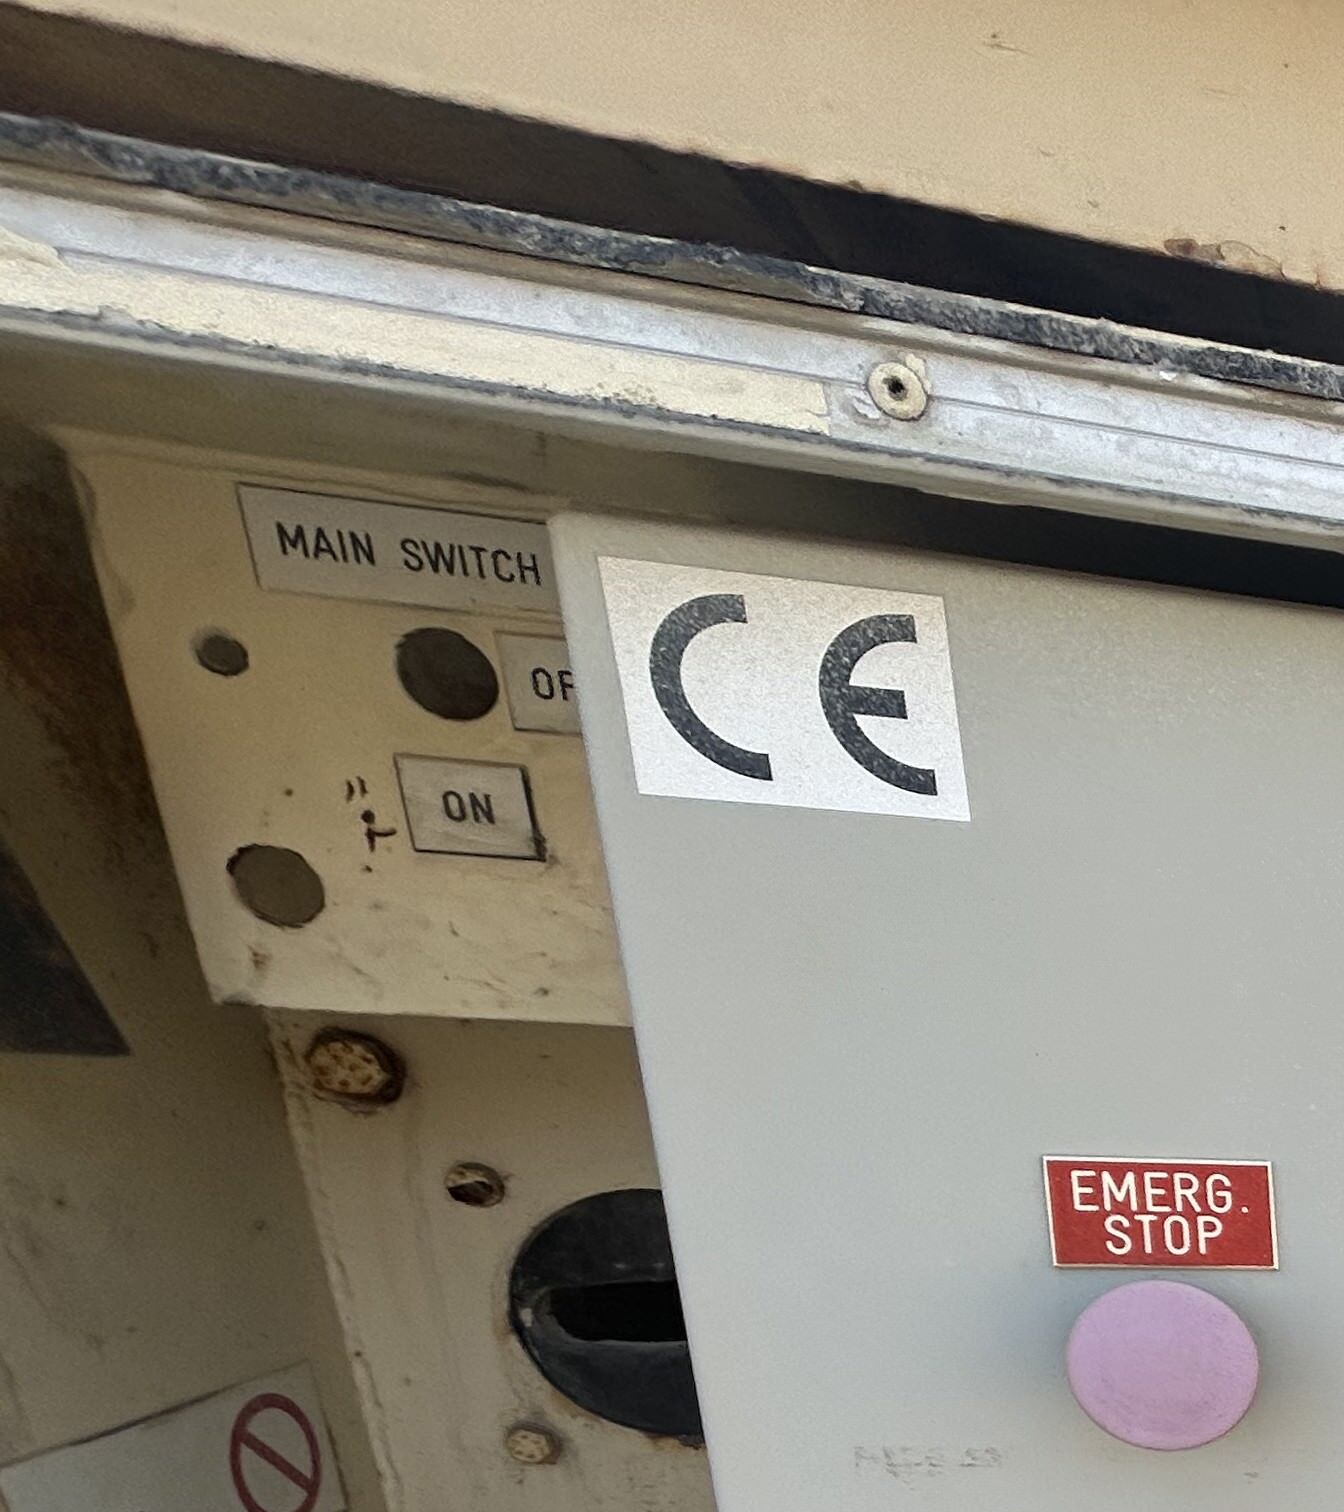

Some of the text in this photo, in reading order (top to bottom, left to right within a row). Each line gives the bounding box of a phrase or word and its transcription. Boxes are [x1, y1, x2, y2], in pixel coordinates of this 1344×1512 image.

[276, 520, 541, 586] MAIN SWITCH
[648, 593, 938, 796] CE
[442, 790, 496, 825] ON
[1070, 1169, 1249, 1213] EMERG.
[1103, 1214, 1223, 1256] STOP
